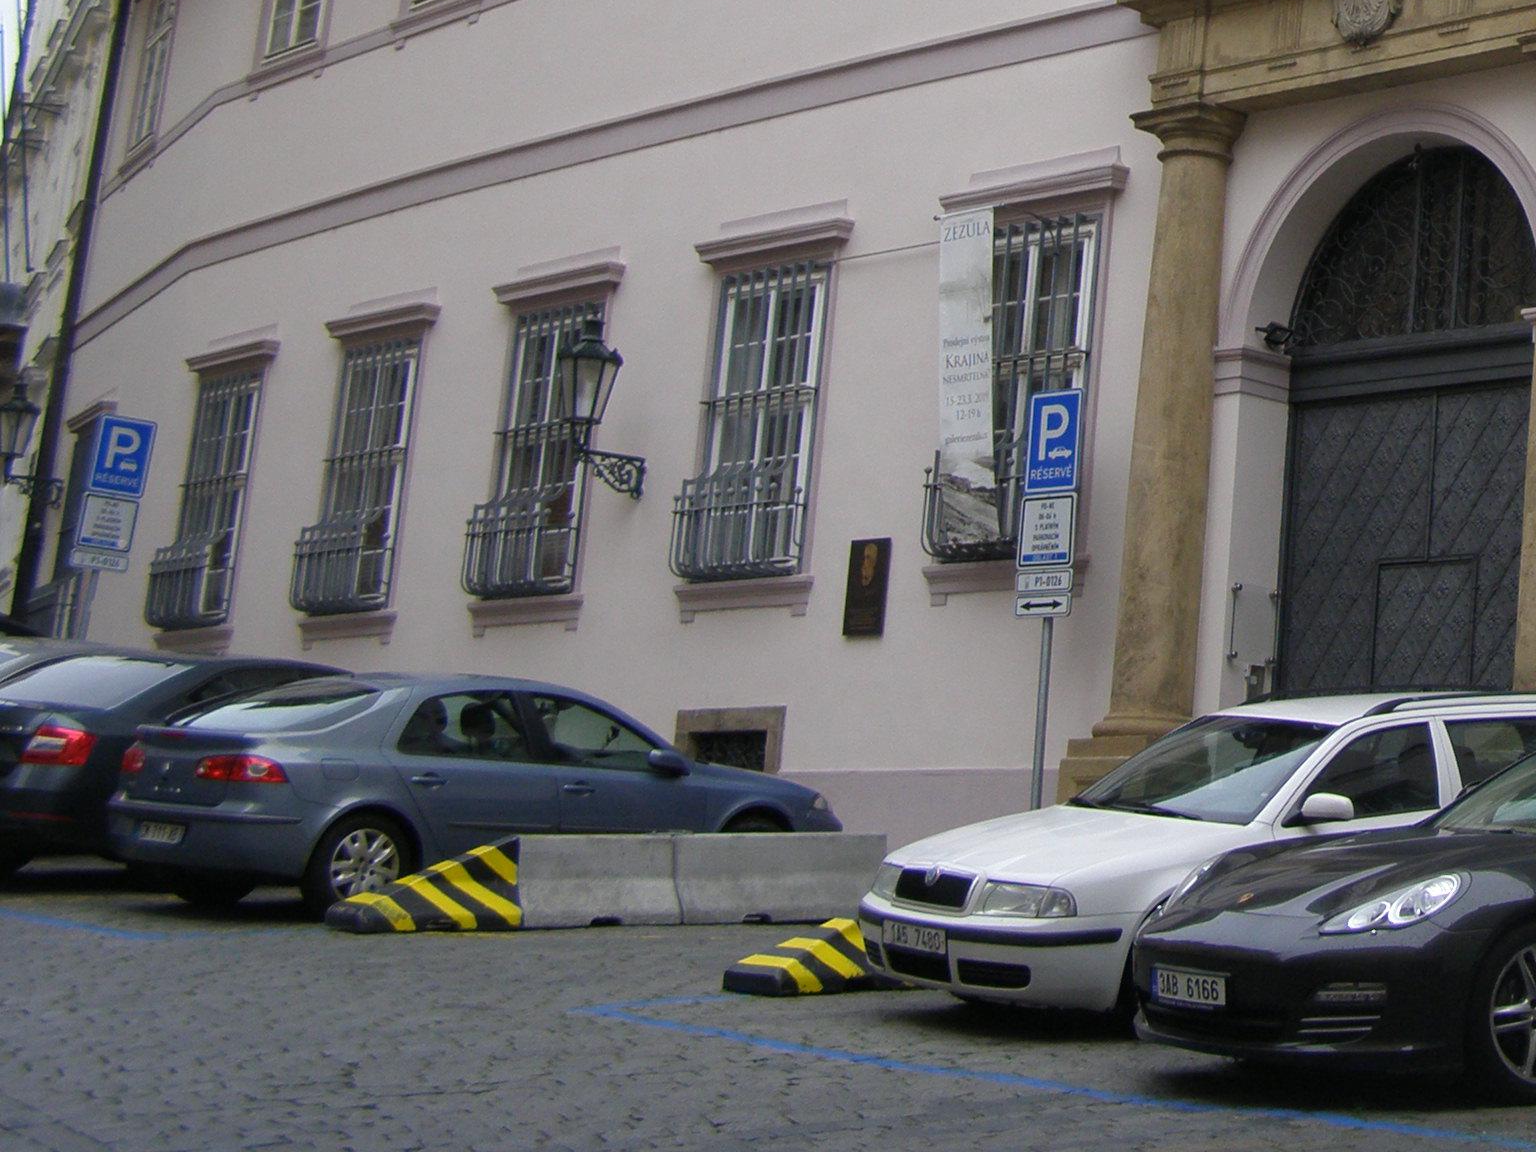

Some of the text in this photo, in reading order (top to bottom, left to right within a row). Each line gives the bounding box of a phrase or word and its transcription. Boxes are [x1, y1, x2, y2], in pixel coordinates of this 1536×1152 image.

[945, 351, 990, 368] KRAJINA
[104, 426, 141, 469] P
[1038, 404, 1069, 461] P
[1159, 972, 1219, 1001] 3AB 6166
